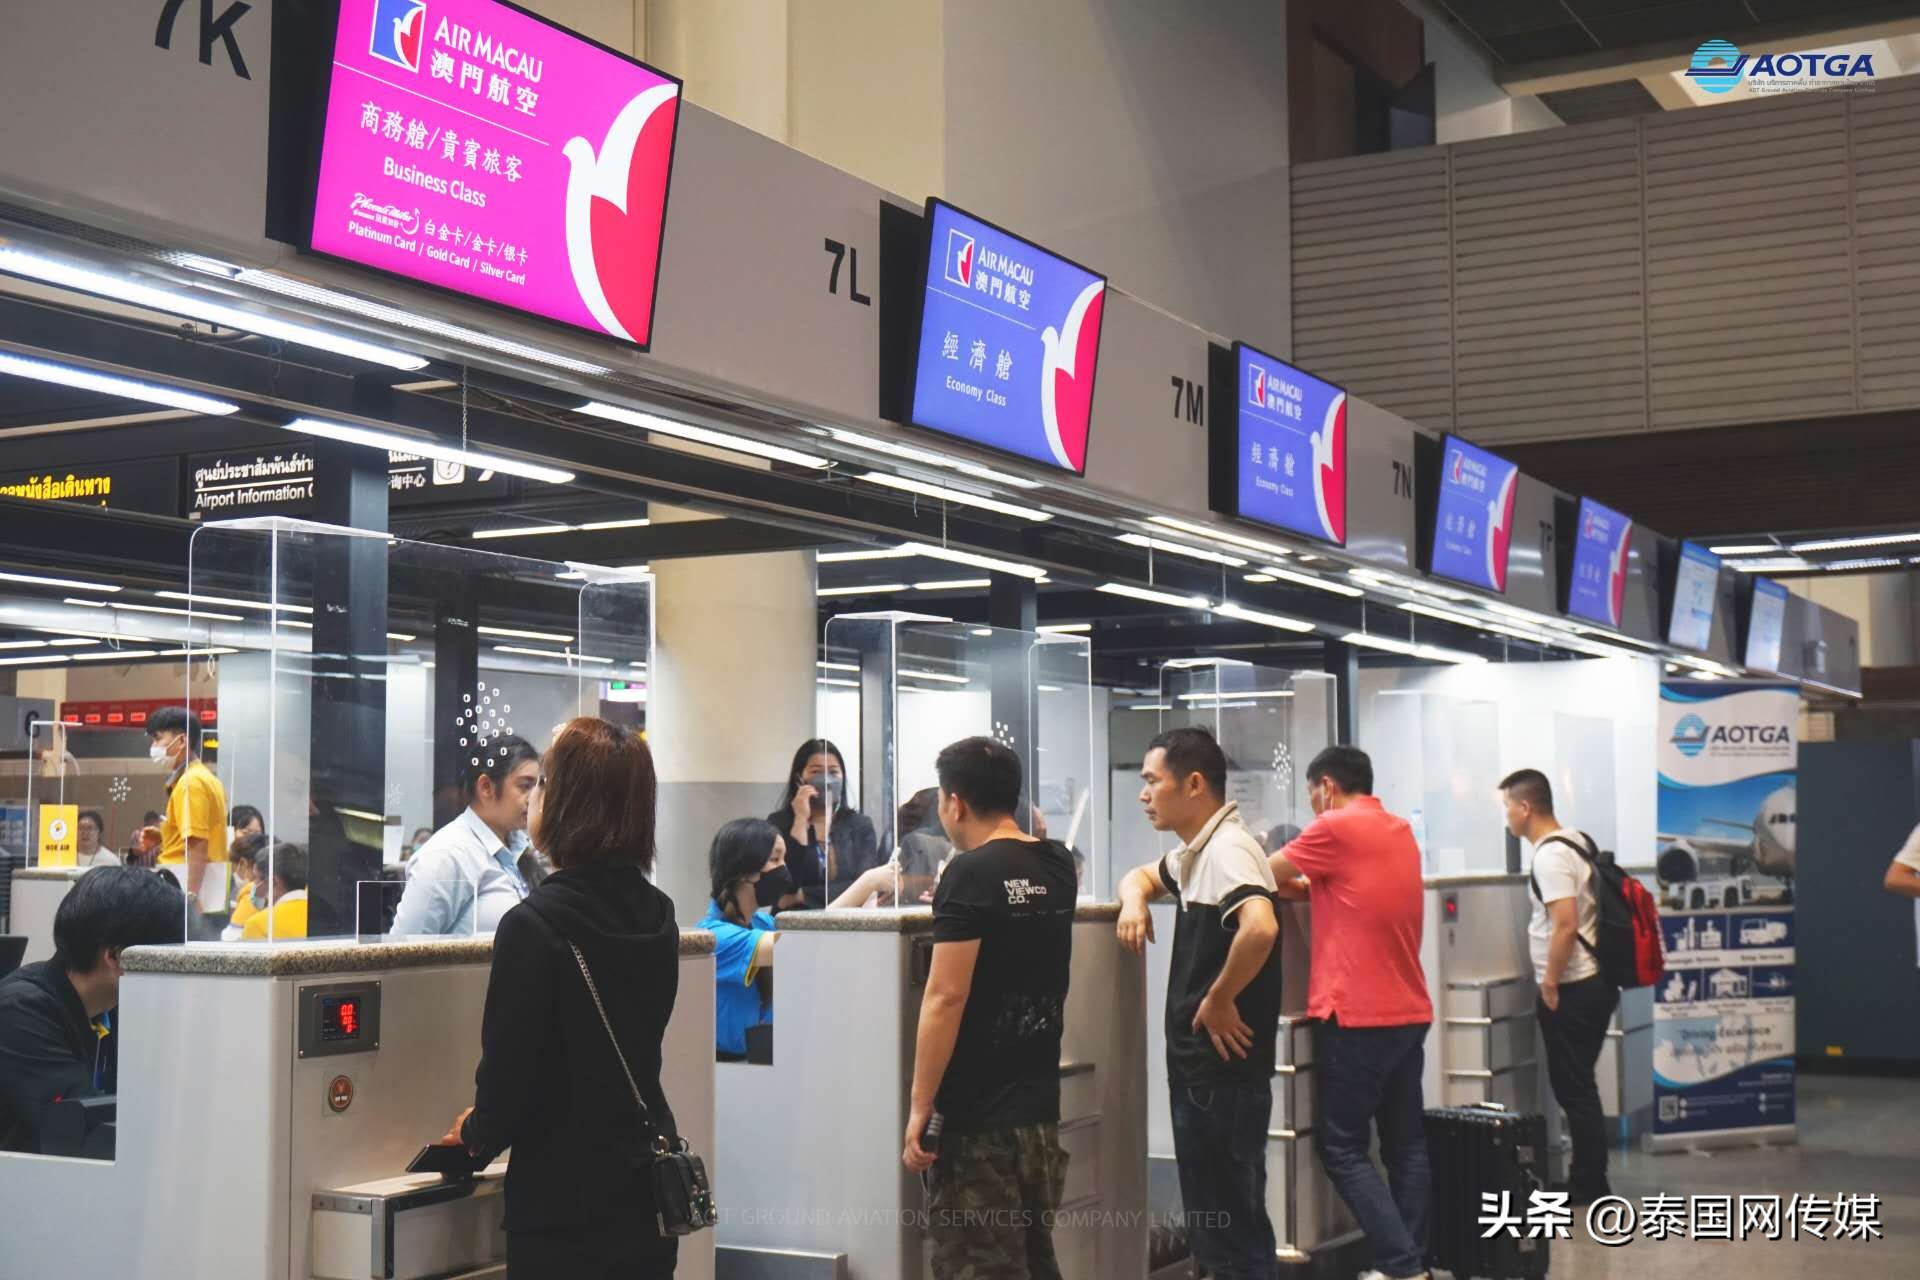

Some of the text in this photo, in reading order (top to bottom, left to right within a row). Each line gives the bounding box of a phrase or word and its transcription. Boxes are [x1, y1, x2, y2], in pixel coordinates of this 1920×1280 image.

[434, 16, 543, 83] AIR MACAU
[430, 48, 539, 118] 澳門航空
[360, 101, 523, 183] 商務艙/貴賓旅客
[384, 155, 487, 208] Business Class
[348, 221, 393, 246] Platinum
[394, 235, 416, 252] Card
[427, 245, 448, 261] Gold
[449, 252, 470, 269] Card
[480, 261, 504, 279] Silver
[505, 270, 526, 286] Card
[824, 237, 871, 306] 7L
[978, 245, 1034, 286] AIR MACAU
[975, 270, 1032, 311] 澳門航空
[942, 331, 1013, 381] 經濟艙
[946, 376, 1007, 407] Economy Class
[1171, 375, 1204, 427] 7M
[1267, 374, 1303, 402] AIR MACAU
[195, 452, 314, 488] ศูนย์ประชาสัมพันธ์ท่า
[1256, 476, 1280, 496] Economy
[1392, 460, 1412, 500] 7N
[195, 490, 235, 510] Airport
[237, 485, 304, 505] Information
[1711, 725, 1790, 744] AOTGA
[1003, 879, 1029, 888] NEW
